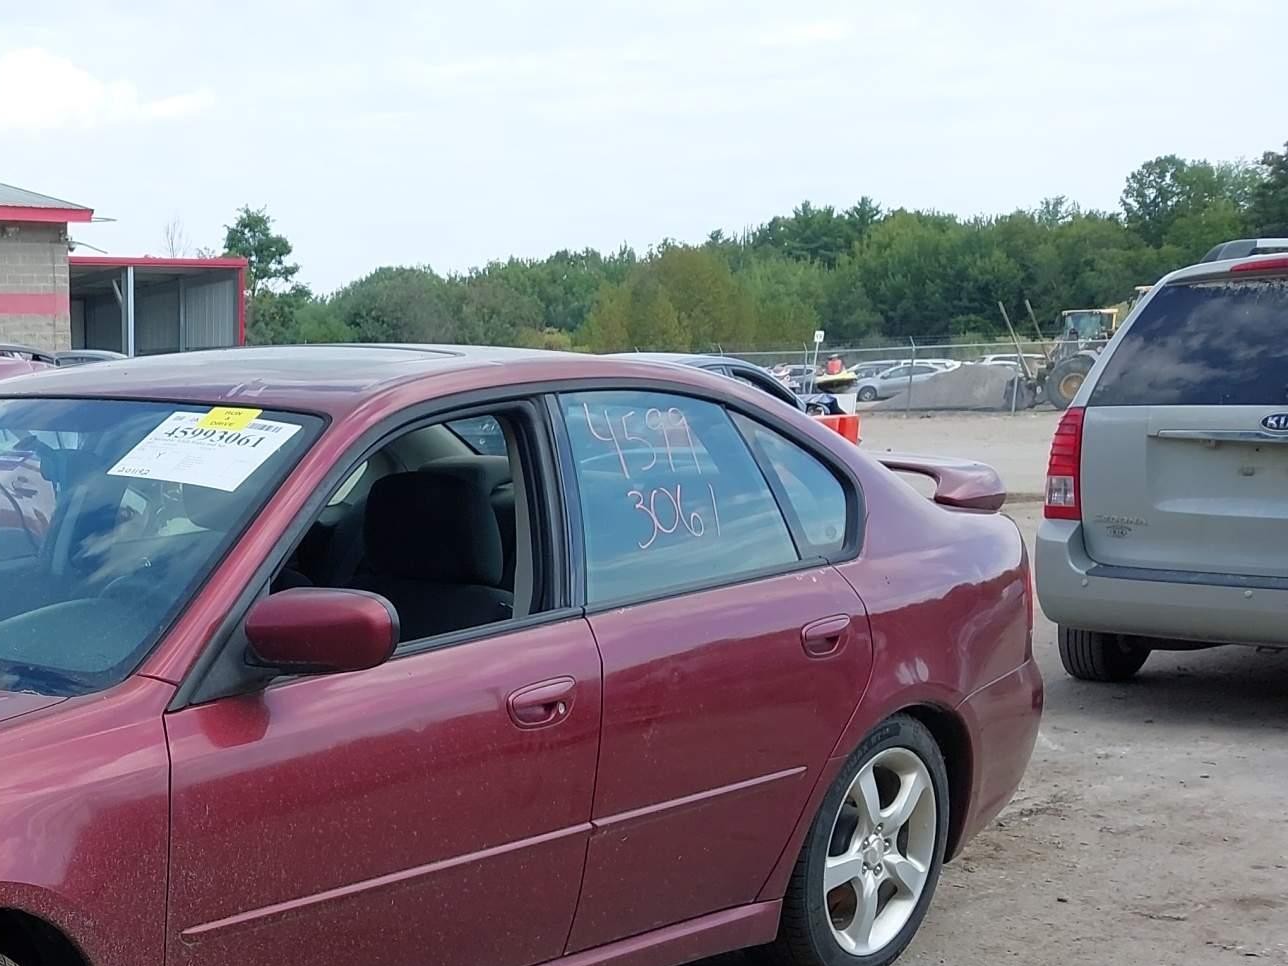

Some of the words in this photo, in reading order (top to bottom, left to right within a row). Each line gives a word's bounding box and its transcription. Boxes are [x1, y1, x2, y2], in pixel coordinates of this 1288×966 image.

[164, 426, 265, 448] 45993061
[583, 402, 702, 479] 4599
[1266, 416, 1288, 429] KI
[627, 483, 721, 549] 3061
